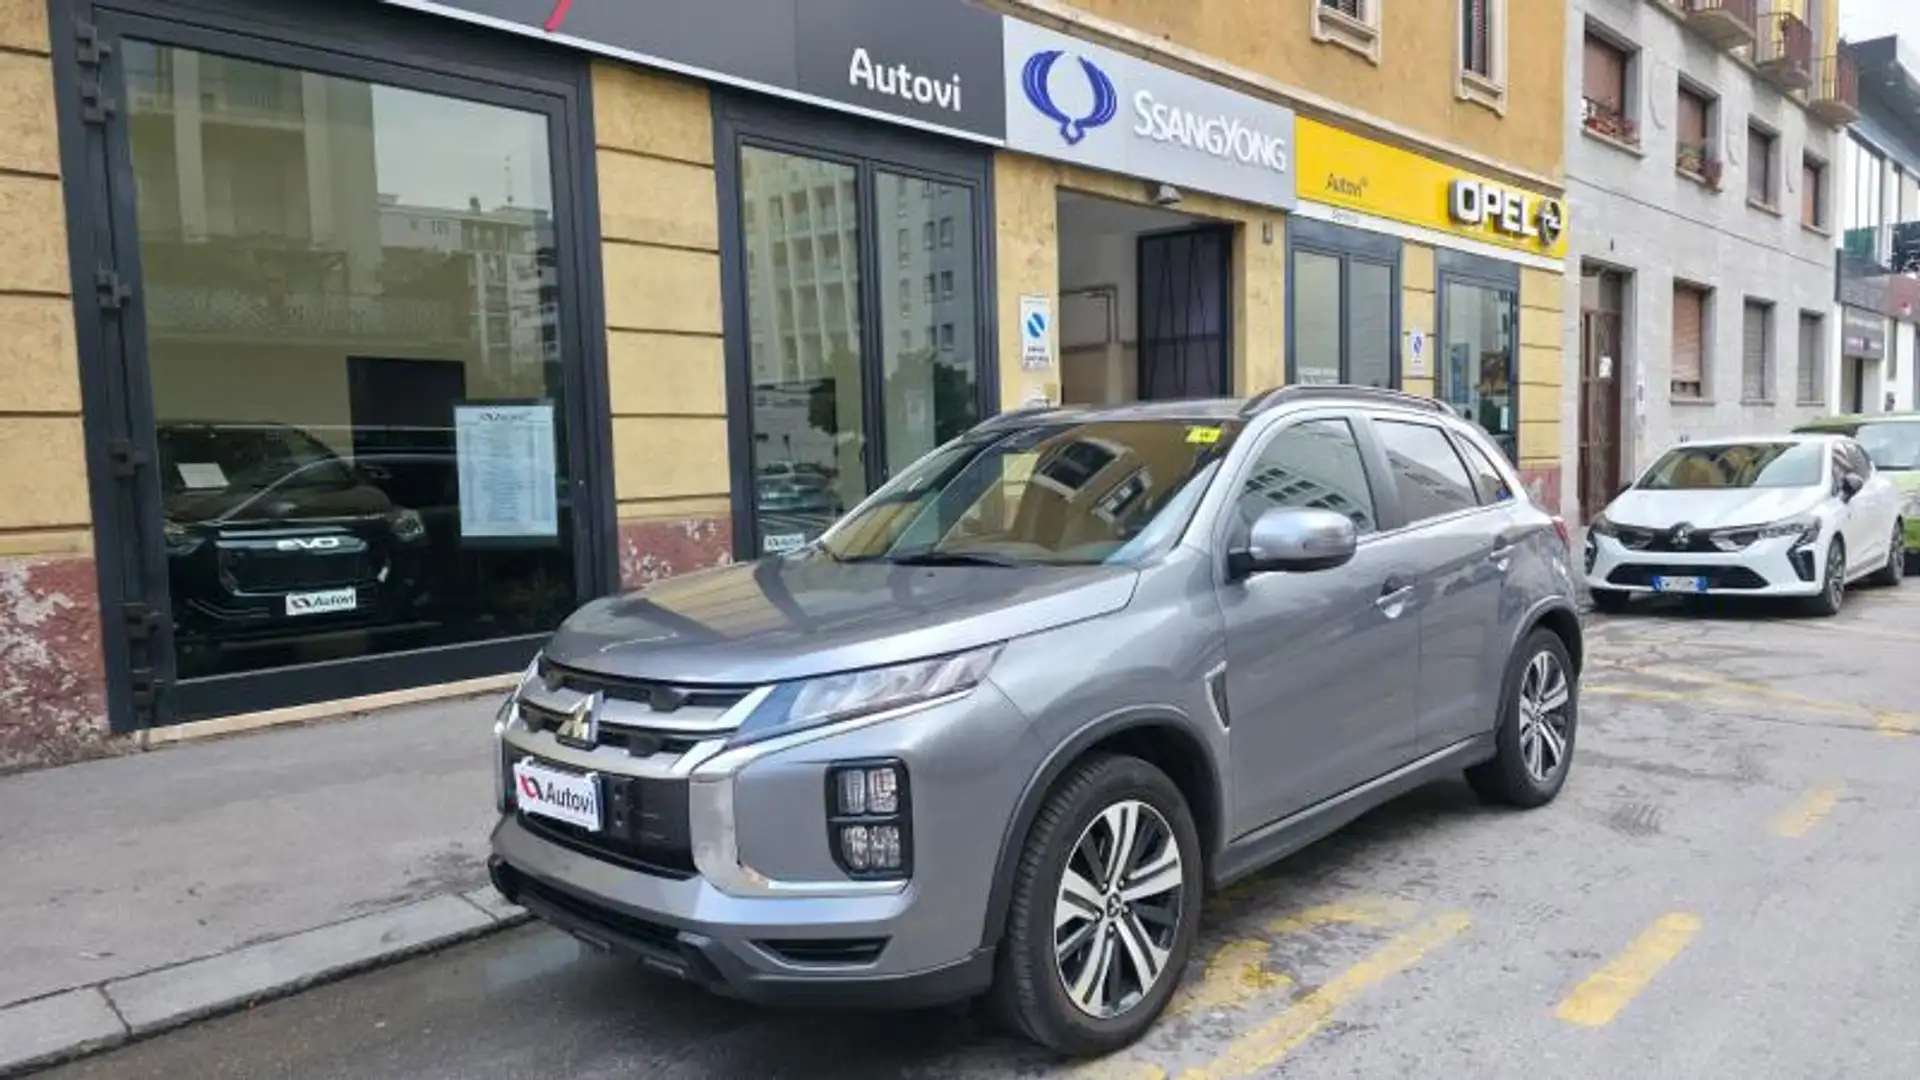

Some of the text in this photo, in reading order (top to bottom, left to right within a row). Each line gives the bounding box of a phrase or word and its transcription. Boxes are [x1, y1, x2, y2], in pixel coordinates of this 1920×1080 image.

[849, 47, 961, 112] Autovi
[1450, 180, 1539, 237] OPEL
[544, 779, 595, 816] Autovi
